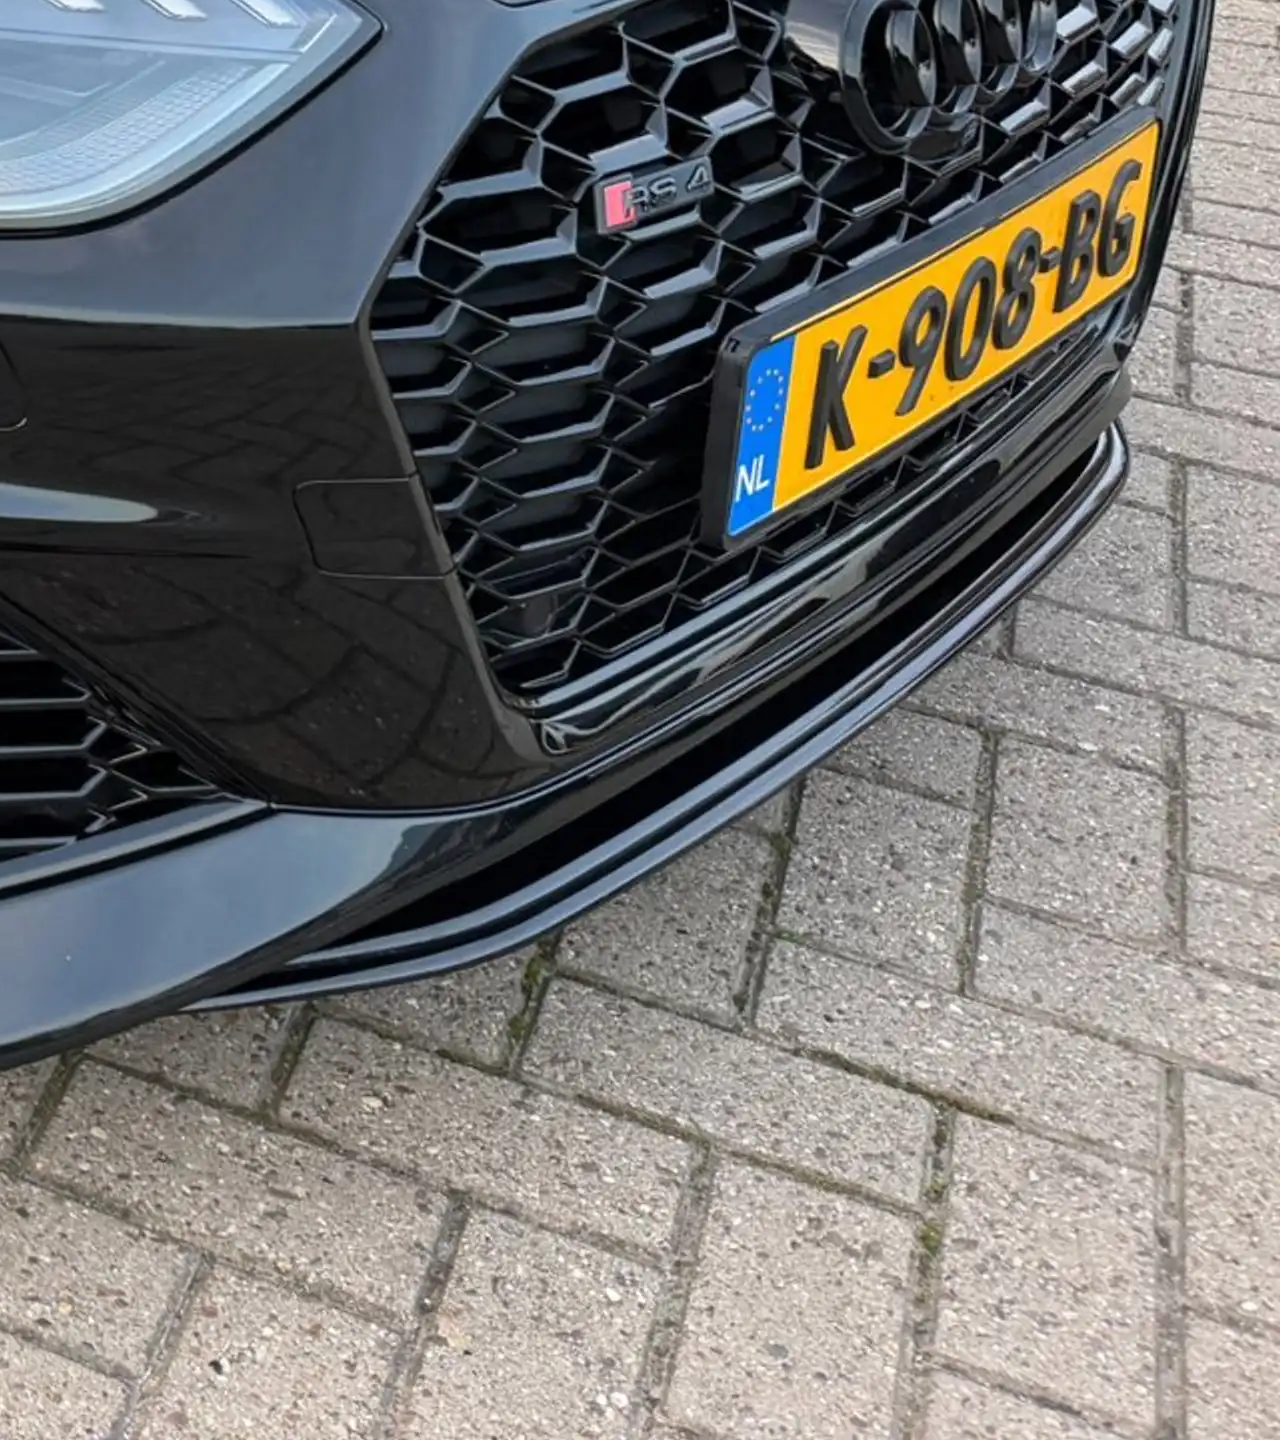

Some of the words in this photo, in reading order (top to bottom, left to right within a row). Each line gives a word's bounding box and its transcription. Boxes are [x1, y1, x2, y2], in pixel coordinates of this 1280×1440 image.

[621, 176, 677, 220] RS
[686, 164, 710, 192] 4
[803, 160, 1143, 471] K-908-BG
[735, 454, 770, 502] NL
